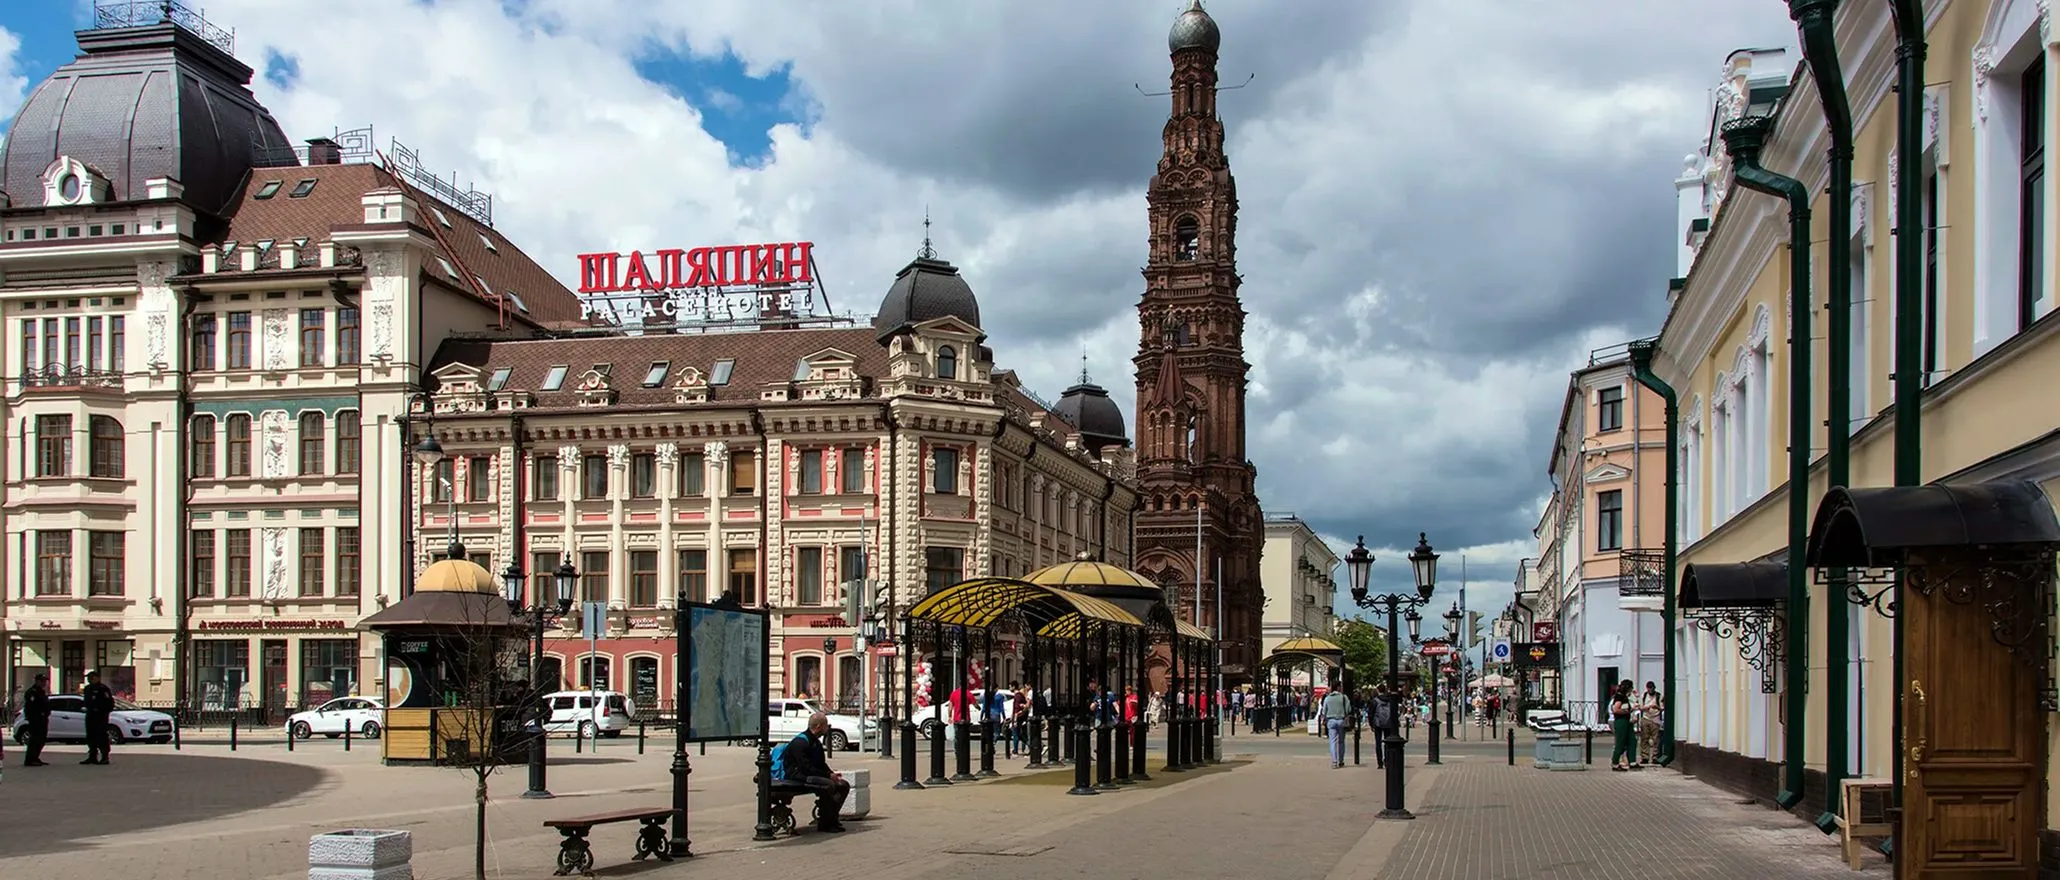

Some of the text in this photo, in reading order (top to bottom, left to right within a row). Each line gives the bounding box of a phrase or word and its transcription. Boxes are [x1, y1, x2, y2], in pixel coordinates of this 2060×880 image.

[577, 242, 814, 292] ШАЛЯПИН
[580, 294, 813, 320] PALACE HOTEL
